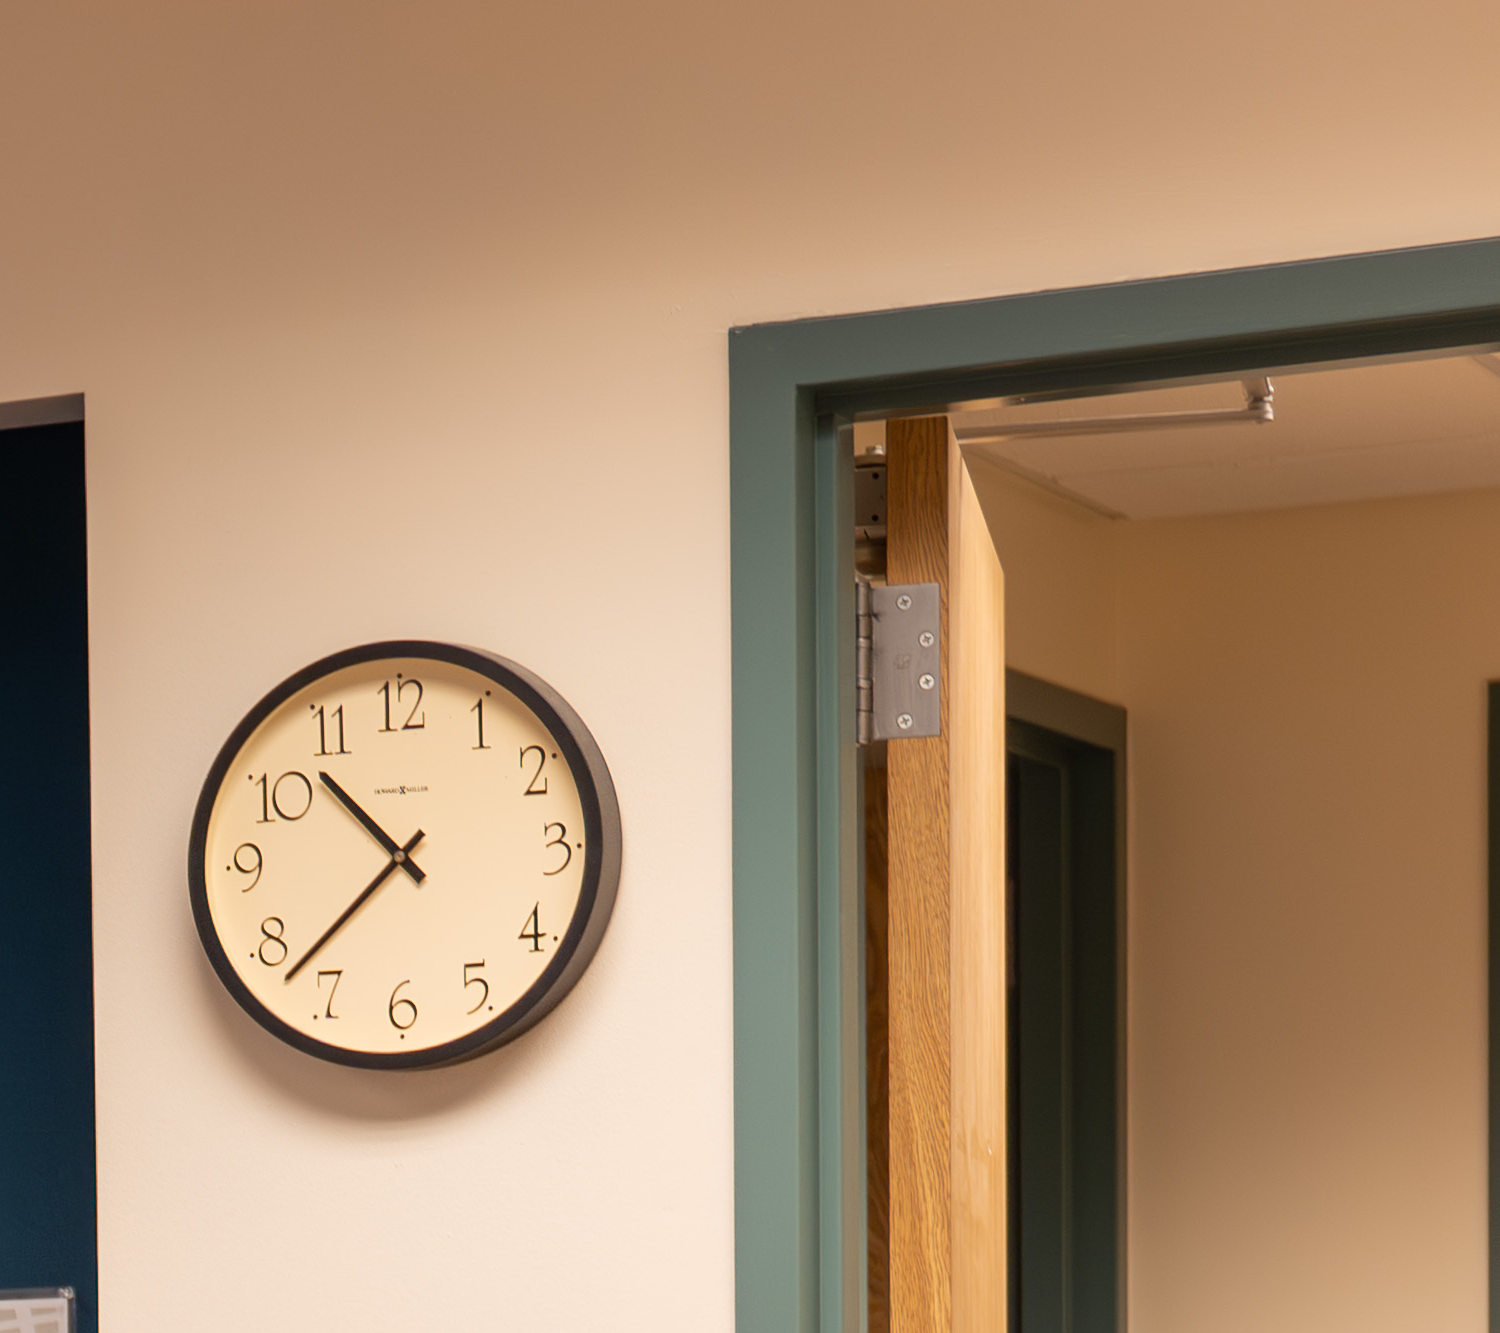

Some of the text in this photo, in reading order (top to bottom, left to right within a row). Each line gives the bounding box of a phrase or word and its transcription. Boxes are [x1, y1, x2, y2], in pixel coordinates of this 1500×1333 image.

[311, 704, 352, 755] 11
[377, 679, 426, 732] 12
[470, 697, 492, 749] 1
[519, 745, 548, 795] 2
[254, 771, 313, 823] 10
[233, 843, 262, 892] 9
[543, 822, 572, 875] 3
[258, 917, 288, 966] 8
[518, 902, 547, 952] 4
[317, 970, 343, 1018] 7
[389, 980, 417, 1029] 6
[463, 959, 489, 1015] 5
